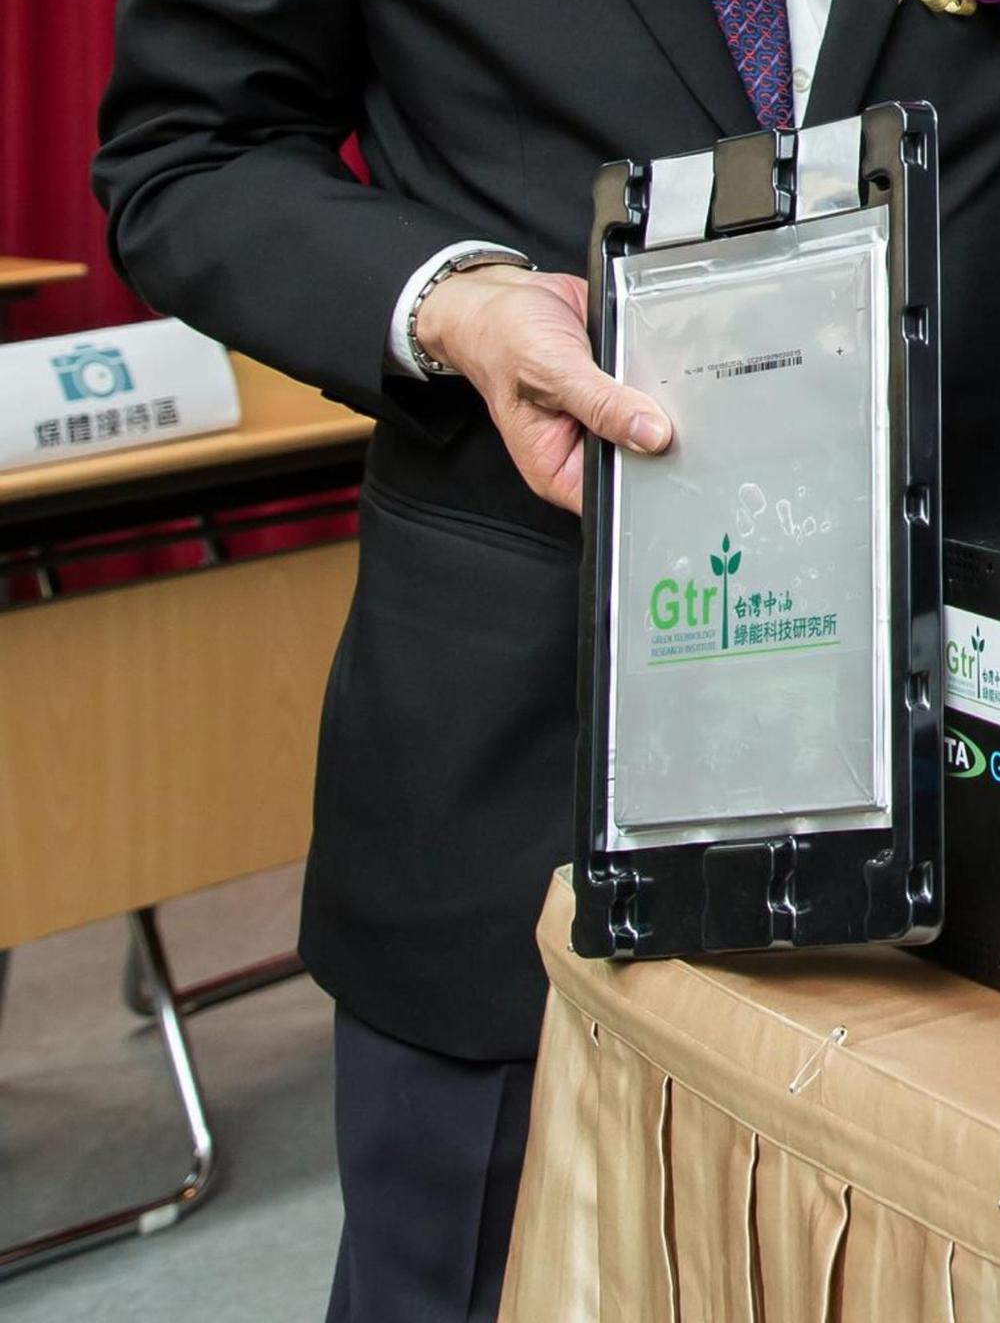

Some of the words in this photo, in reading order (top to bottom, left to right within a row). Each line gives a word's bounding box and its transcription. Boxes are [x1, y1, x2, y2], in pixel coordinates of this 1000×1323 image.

[734, 590, 793, 619] 台灣中油
[734, 613, 838, 646] 綠能科技研究所
